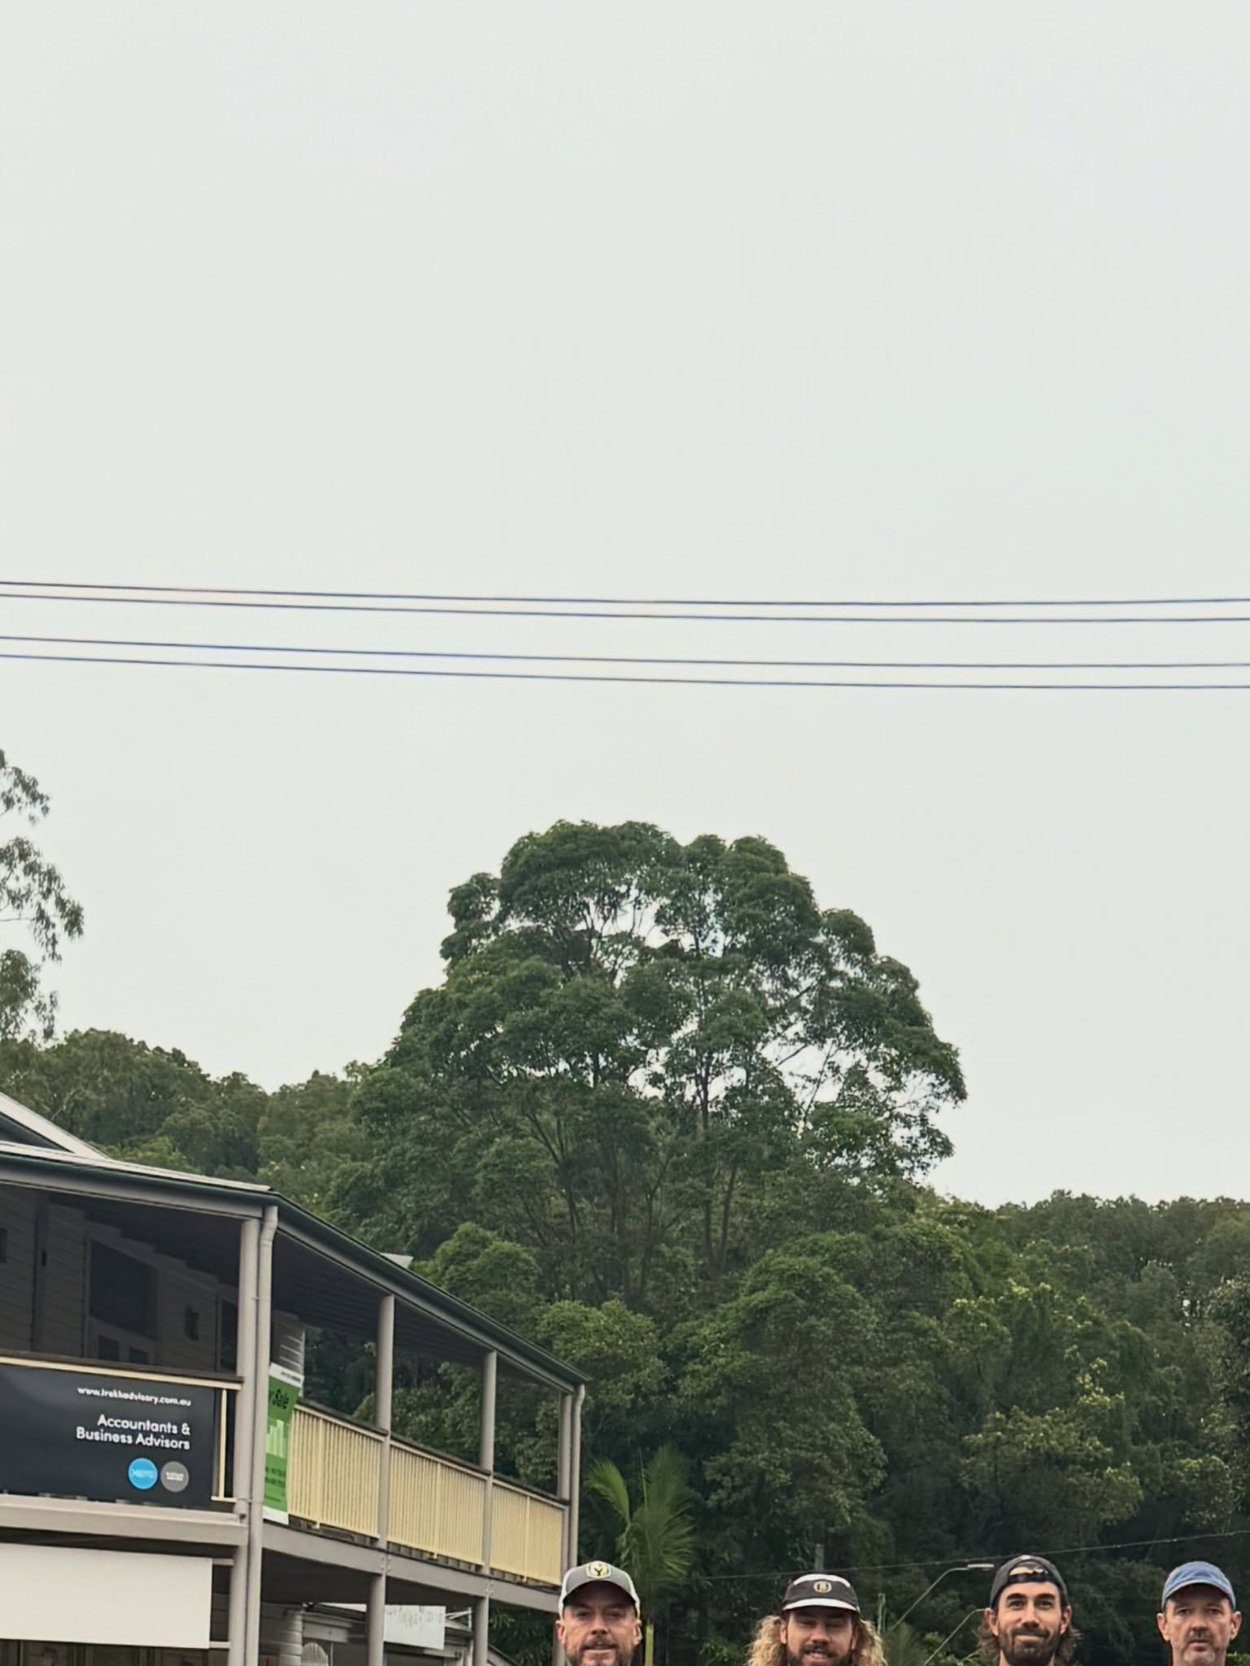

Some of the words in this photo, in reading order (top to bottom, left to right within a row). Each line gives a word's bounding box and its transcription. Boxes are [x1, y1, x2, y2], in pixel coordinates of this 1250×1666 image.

[97, 1414, 178, 1435] Accountants
[181, 1422, 191, 1436] &
[76, 1426, 133, 1445] Business
[135, 1433, 190, 1451] Advisors
